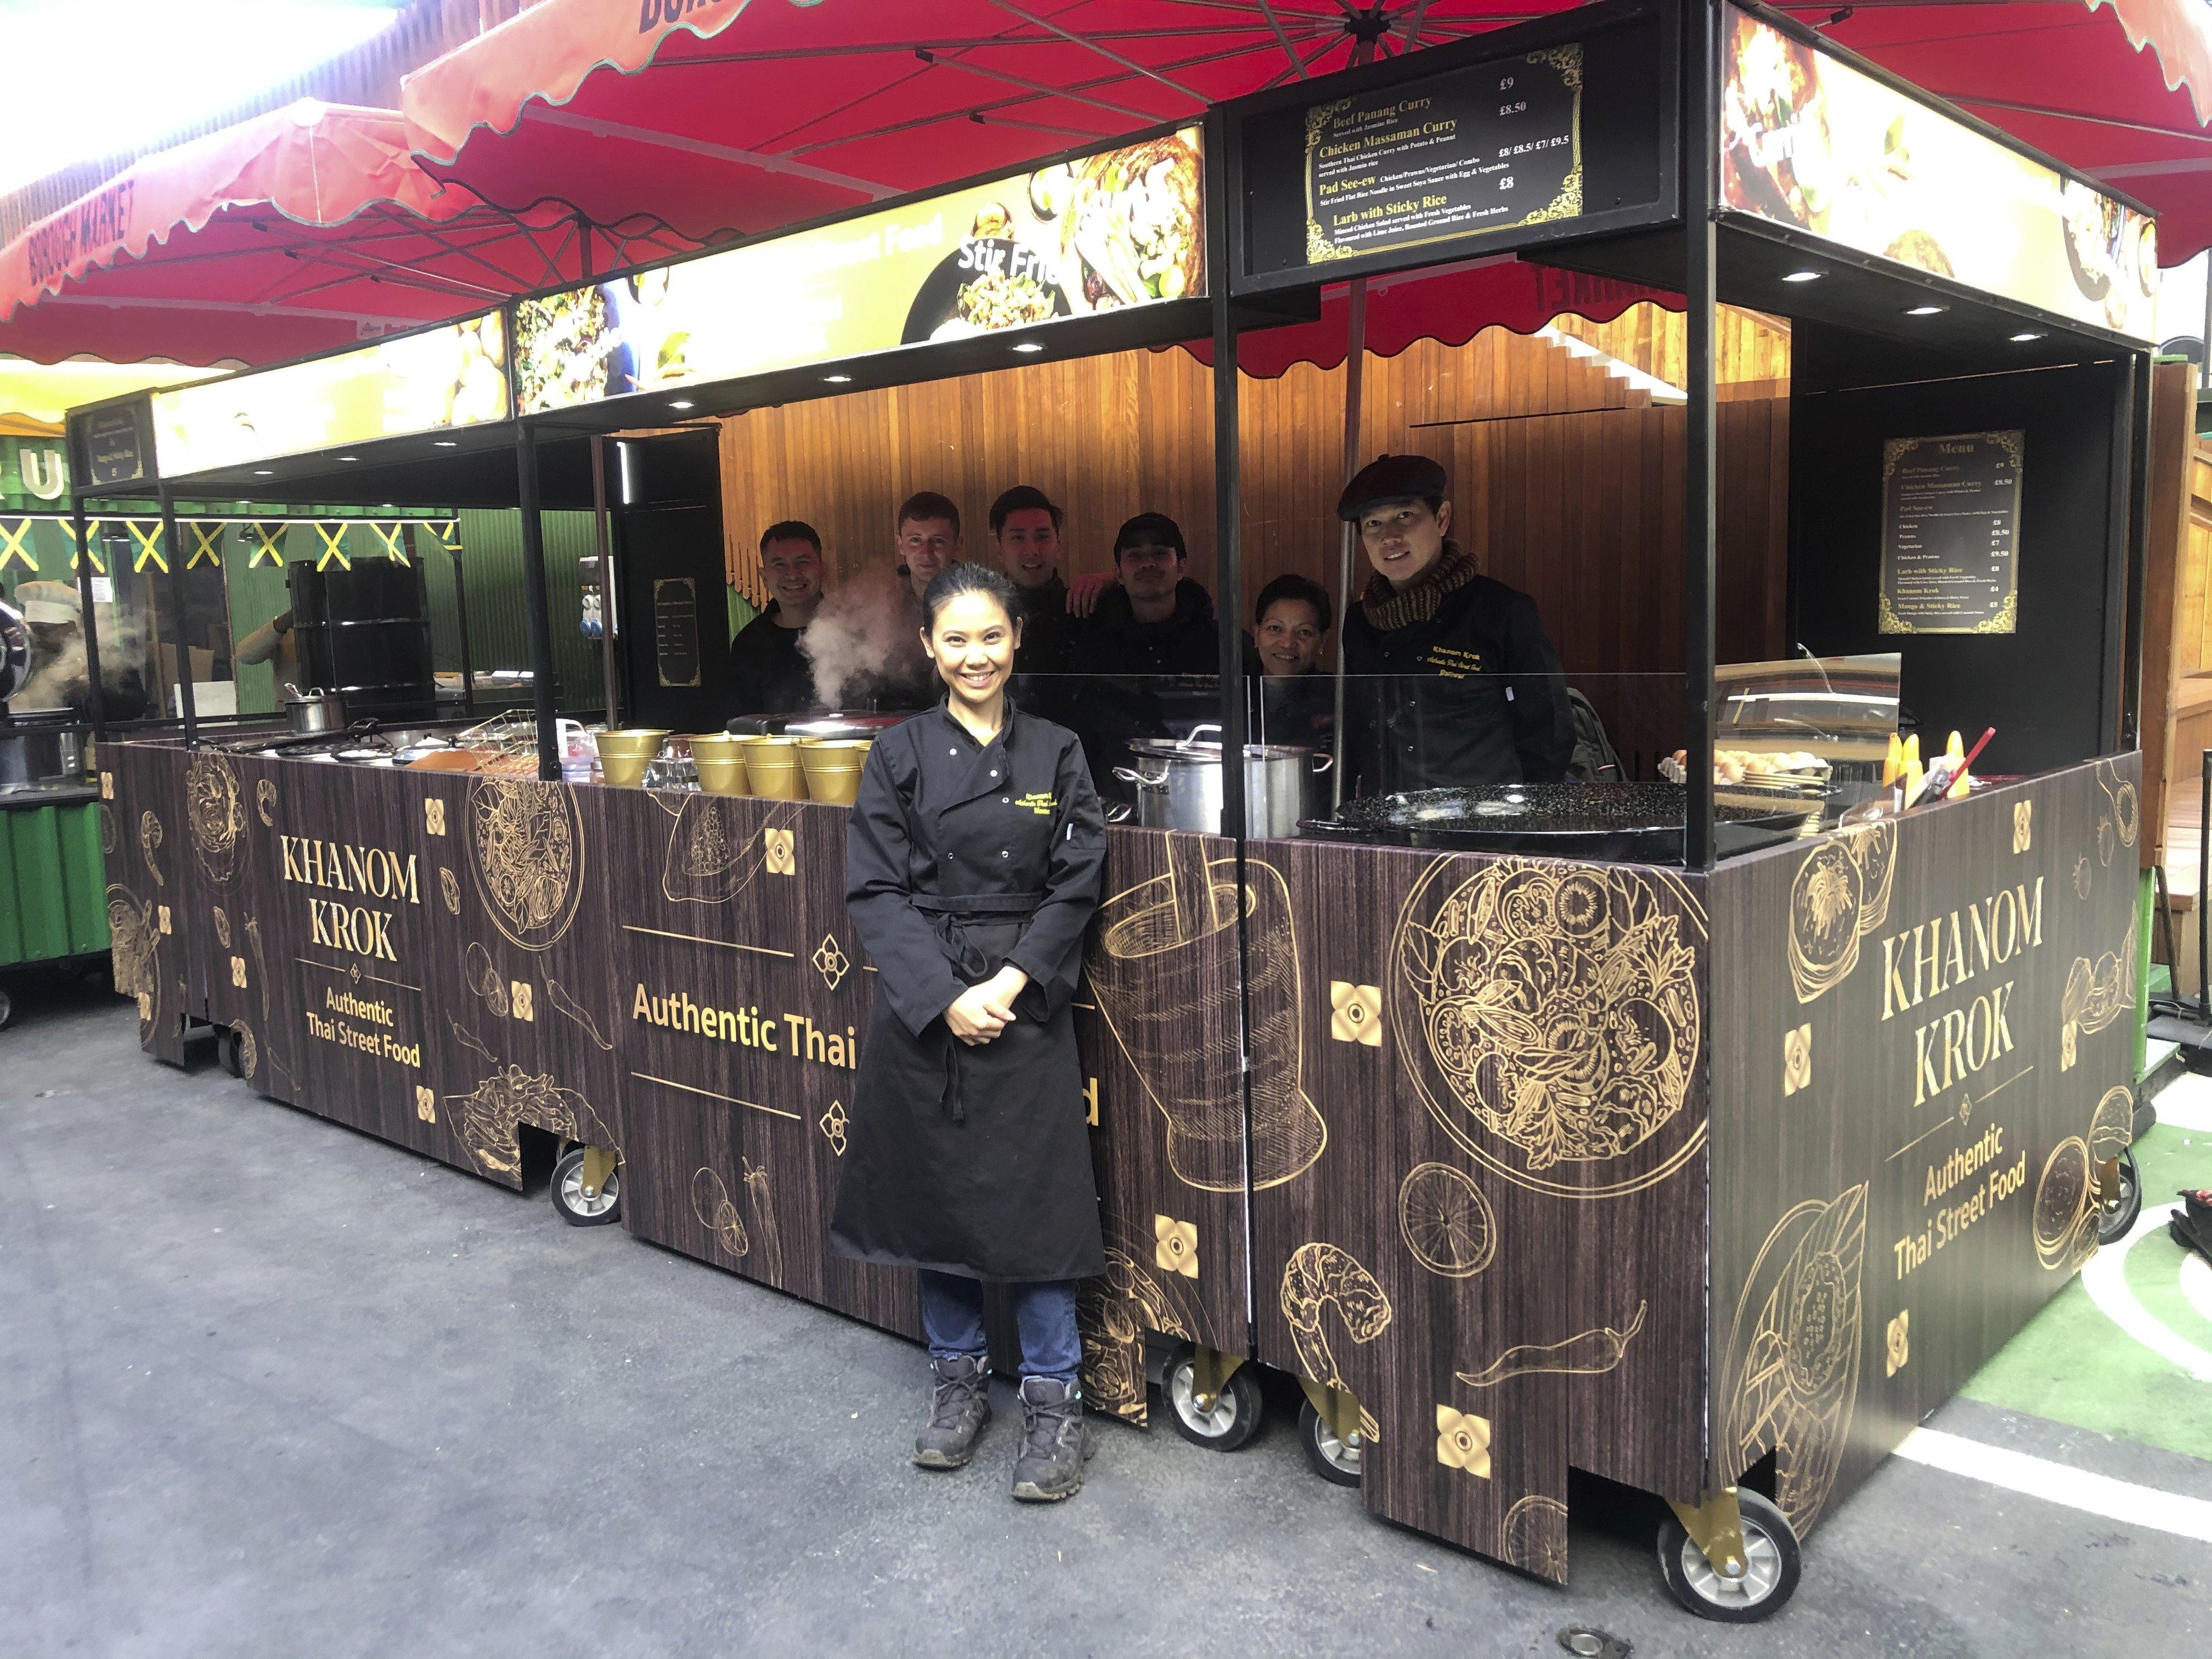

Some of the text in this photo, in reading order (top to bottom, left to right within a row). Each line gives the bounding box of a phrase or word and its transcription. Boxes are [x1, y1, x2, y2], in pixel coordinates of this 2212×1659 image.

[1500, 77, 1514, 91] £9
[1333, 98, 1431, 129] Beef Panang Curry
[1500, 101, 1526, 115] £8.50
[1318, 160, 1342, 169] Southern
[1356, 151, 1378, 161] Chicken
[1379, 148, 1395, 156] Curry
[1436, 134, 1455, 143] Peanut
[1319, 119, 1457, 158] Chicken Massaman Curry
[1551, 135, 1569, 147] £9.5
[1319, 181, 1339, 195] Pad
[1341, 176, 1376, 191] See-ew
[1459, 157, 1480, 167] Combo
[1331, 195, 1345, 205] Fried
[1369, 186, 1389, 196] Noodle
[1413, 179, 1426, 189] Soya
[1427, 176, 1444, 184] Sauce
[1445, 171, 1458, 180] with
[1459, 169, 1471, 179] Egg
[1471, 167, 1477, 175] &
[1479, 162, 1510, 174] Vegetables
[1499, 176, 1514, 190] £8
[1333, 195, 1447, 226] Larb with Sticky Rice
[1353, 222, 1375, 232] Chicken
[1392, 215, 1409, 223] served
[1410, 212, 1423, 220] with
[1424, 208, 1440, 217] Fresh
[1441, 204, 1471, 215] Vegetables
[1361, 230, 1372, 239] with
[1428, 216, 1451, 226] Ground
[1452, 213, 1464, 222] Rice
[1465, 211, 1471, 219] &
[1472, 209, 1489, 218] Fresh
[1491, 206, 1509, 215] Herbs
[957, 236, 1006, 274] Stir
[1939, 443, 1974, 455] Menu
[280, 835, 420, 904] KHANOM
[309, 898, 397, 962] KROK
[1881, 876, 2045, 1021] KHANOM
[326, 986, 393, 1027] Authentic
[307, 1011, 421, 1069] Thai Street Food
[633, 983, 856, 1069] Authentic Thai
[1914, 980, 2015, 1108] KROK
[1923, 1122, 2003, 1207] Authentic
[1894, 1150, 2026, 1280] Thai Street Food
